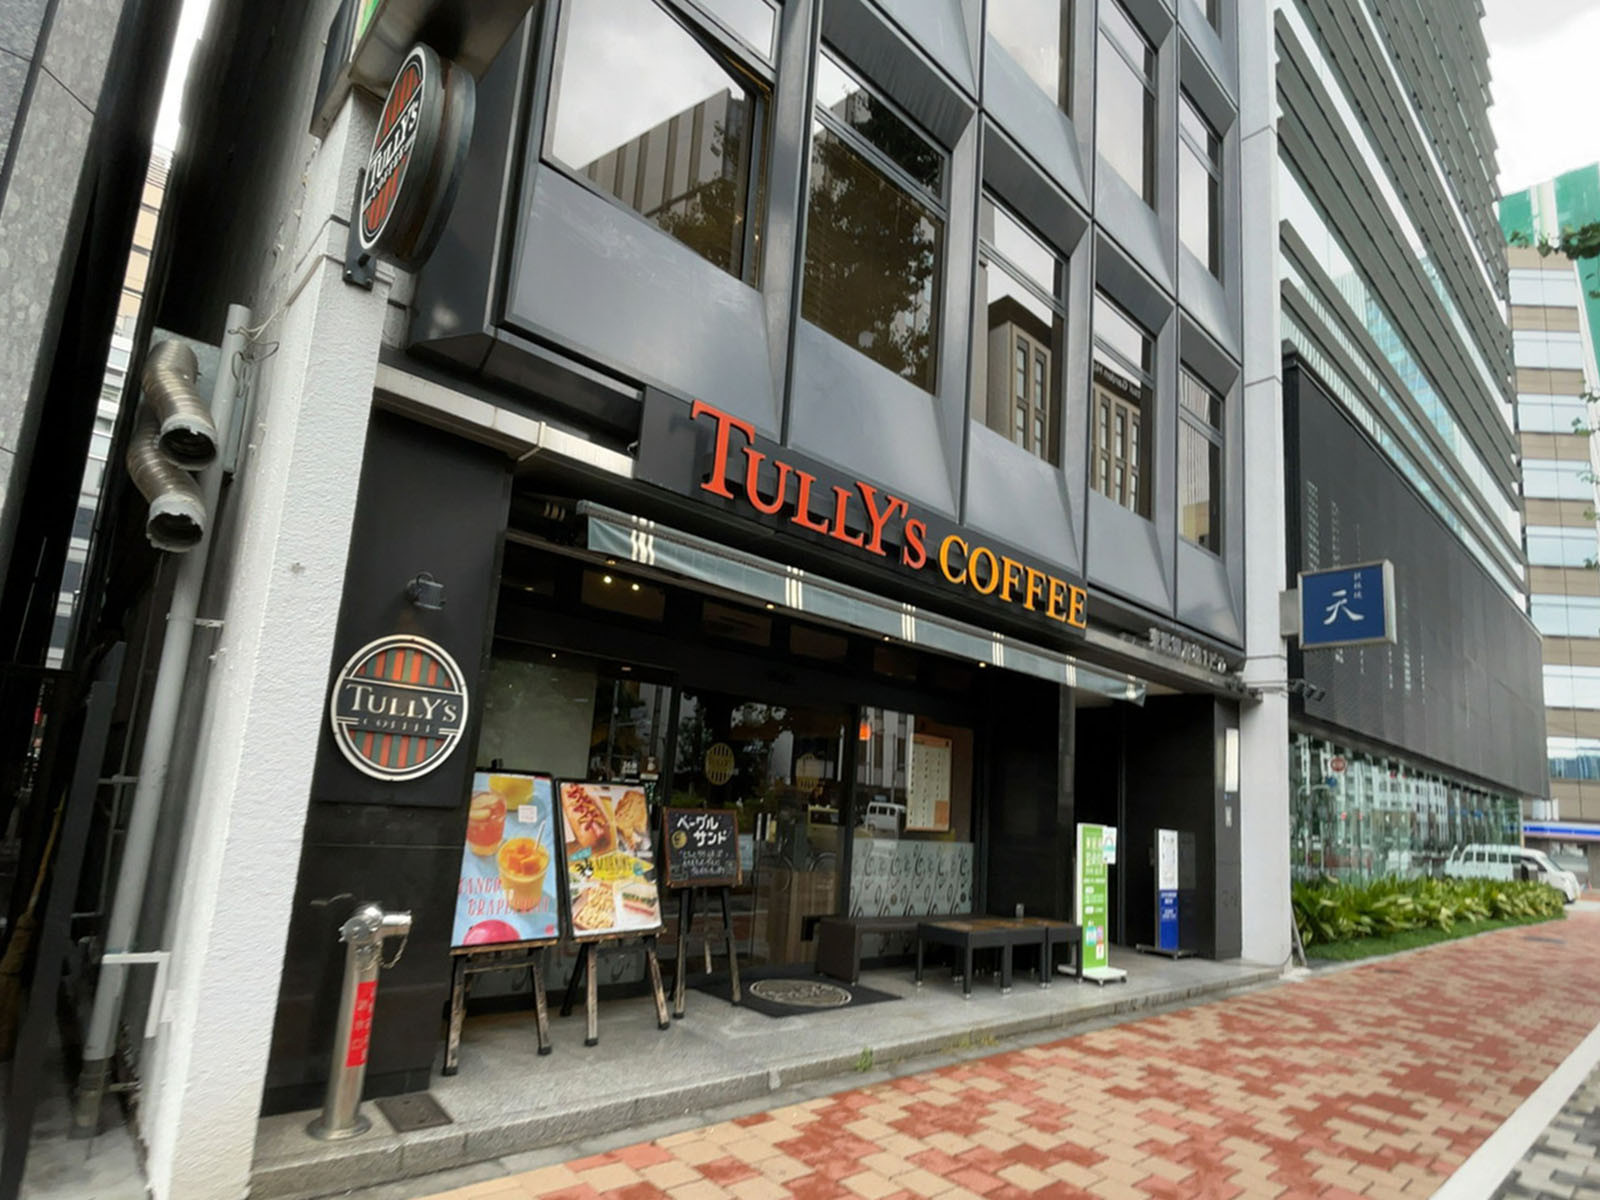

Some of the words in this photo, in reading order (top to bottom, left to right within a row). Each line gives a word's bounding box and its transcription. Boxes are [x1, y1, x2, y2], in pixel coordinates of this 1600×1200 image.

[691, 400, 927, 569] TULLY'S
[939, 535, 1088, 629] COFFEE
[345, 683, 457, 723] TULLY'S
[677, 813, 719, 830] ベーグル
[693, 829, 727, 847] サンド
